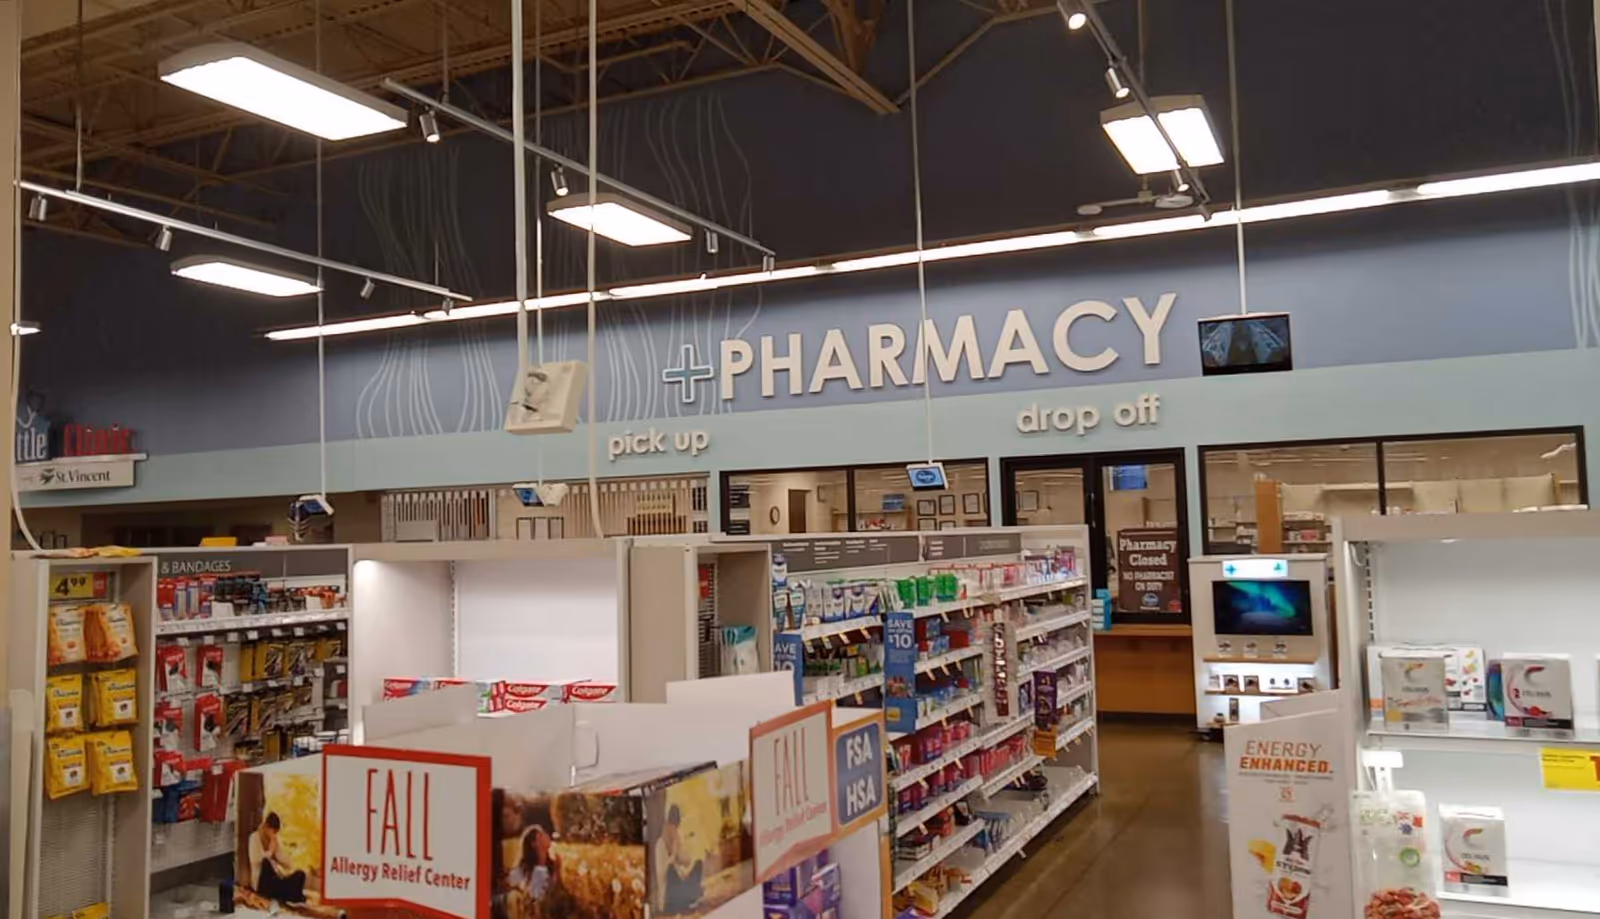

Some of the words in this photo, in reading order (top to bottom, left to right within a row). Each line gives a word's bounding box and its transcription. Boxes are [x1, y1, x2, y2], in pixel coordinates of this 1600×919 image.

[719, 292, 1177, 400] PHARMACY
[1017, 401, 1100, 437] drop
[1113, 394, 1162, 427] off
[607, 430, 665, 461] pick
[674, 430, 709, 457] up
[1119, 538, 1177, 553] Pharmacy
[1129, 553, 1168, 567] Closed
[161, 562, 169, 574] &
[172, 560, 232, 574] BANDAGES
[774, 643, 796, 655] AVE
[507, 684, 542, 696] Colgate
[571, 685, 610, 698] Colgate
[845, 731, 873, 769] FSA
[1245, 740, 1322, 759] ENERGY
[774, 727, 809, 816] FALL
[846, 775, 876, 817] HSA
[366, 768, 434, 862] FALL
[330, 856, 379, 882] Allergy
[381, 862, 422, 883] Relief
[424, 868, 471, 891] Center
